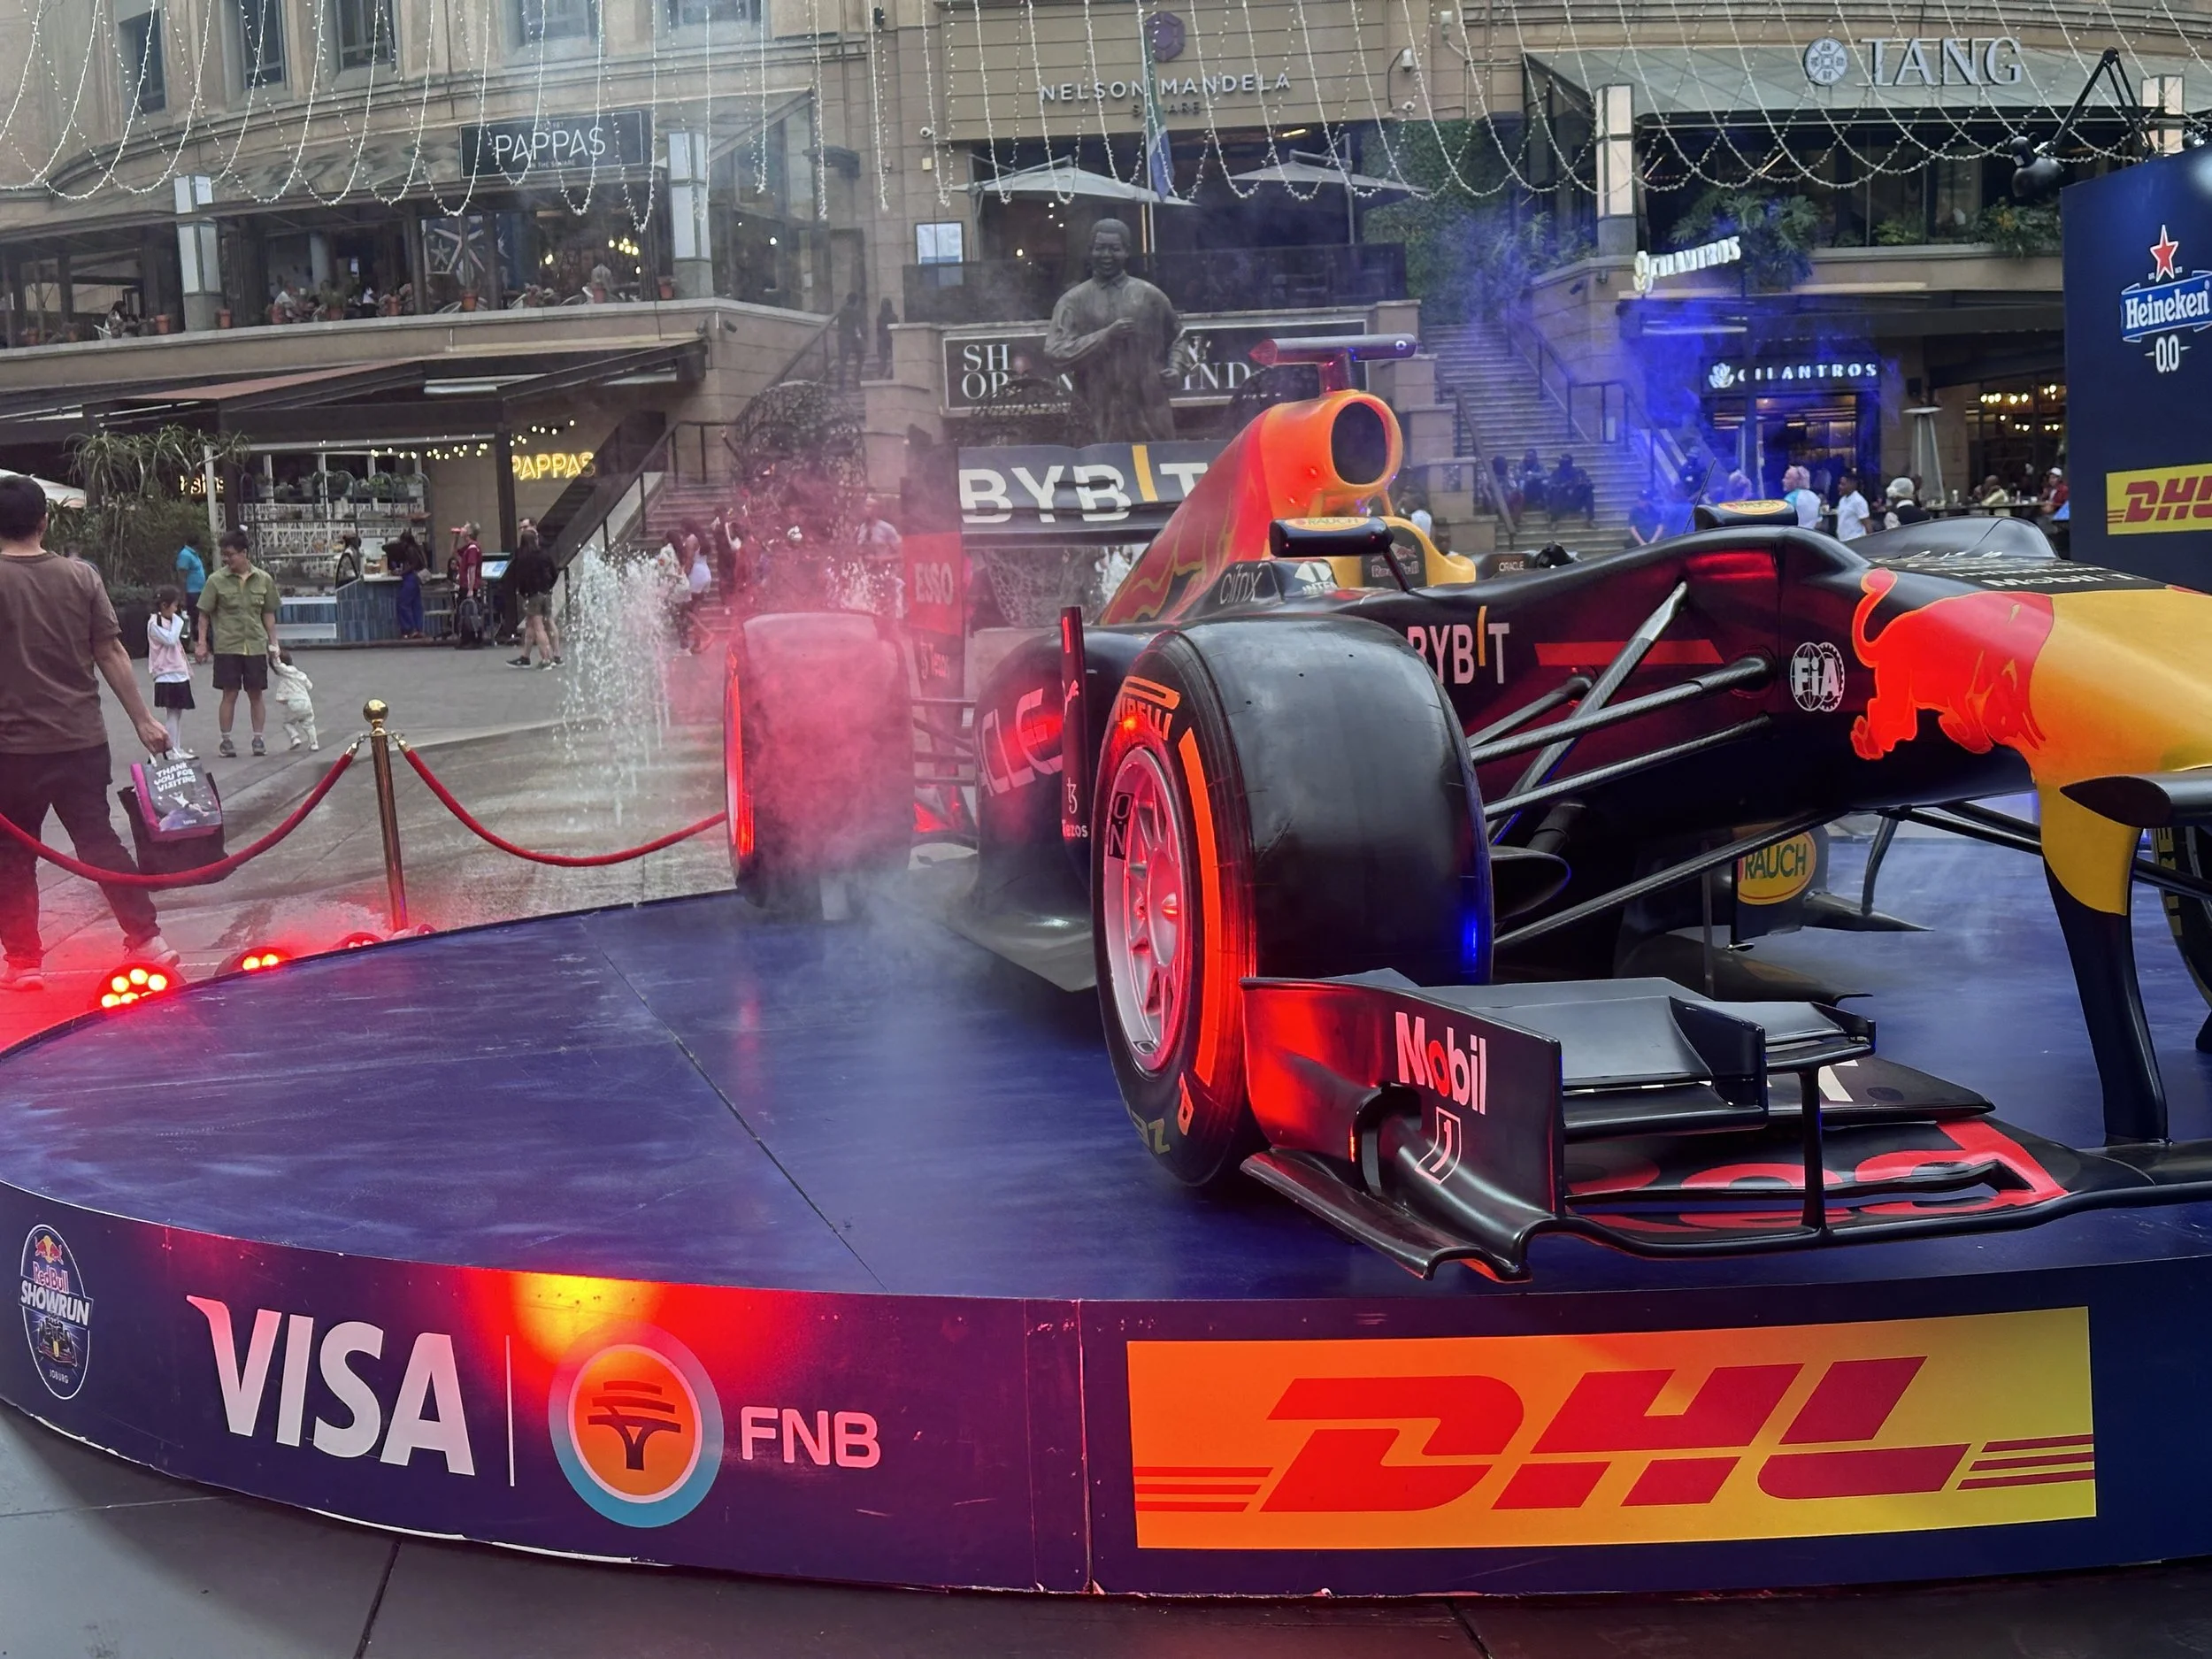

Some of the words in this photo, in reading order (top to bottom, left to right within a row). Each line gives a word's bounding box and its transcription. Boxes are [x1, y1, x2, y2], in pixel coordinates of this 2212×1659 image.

[1856, 35, 2023, 87] TANG
[1040, 81, 1146, 102] NELSON
[1160, 73, 1291, 97] MANDELA
[1132, 103, 1201, 117] SARE
[495, 127, 606, 163] PAPPAS
[2124, 288, 2210, 330] Heineken
[1737, 363, 1877, 382] CILANTROS
[2155, 334, 2180, 374] 0.0
[511, 452, 596, 480] PAPPAS
[959, 444, 1209, 524] BYBIT
[156, 761, 188, 779] THANK
[1744, 843, 1807, 880] RAUCH
[1395, 1011, 1486, 1115] Mobil
[20, 1279, 89, 1325] SHOWRUN
[186, 1294, 476, 1476] VISA
[741, 1406, 881, 1469] FNB
[1259, 1355, 1970, 1513] DHL
